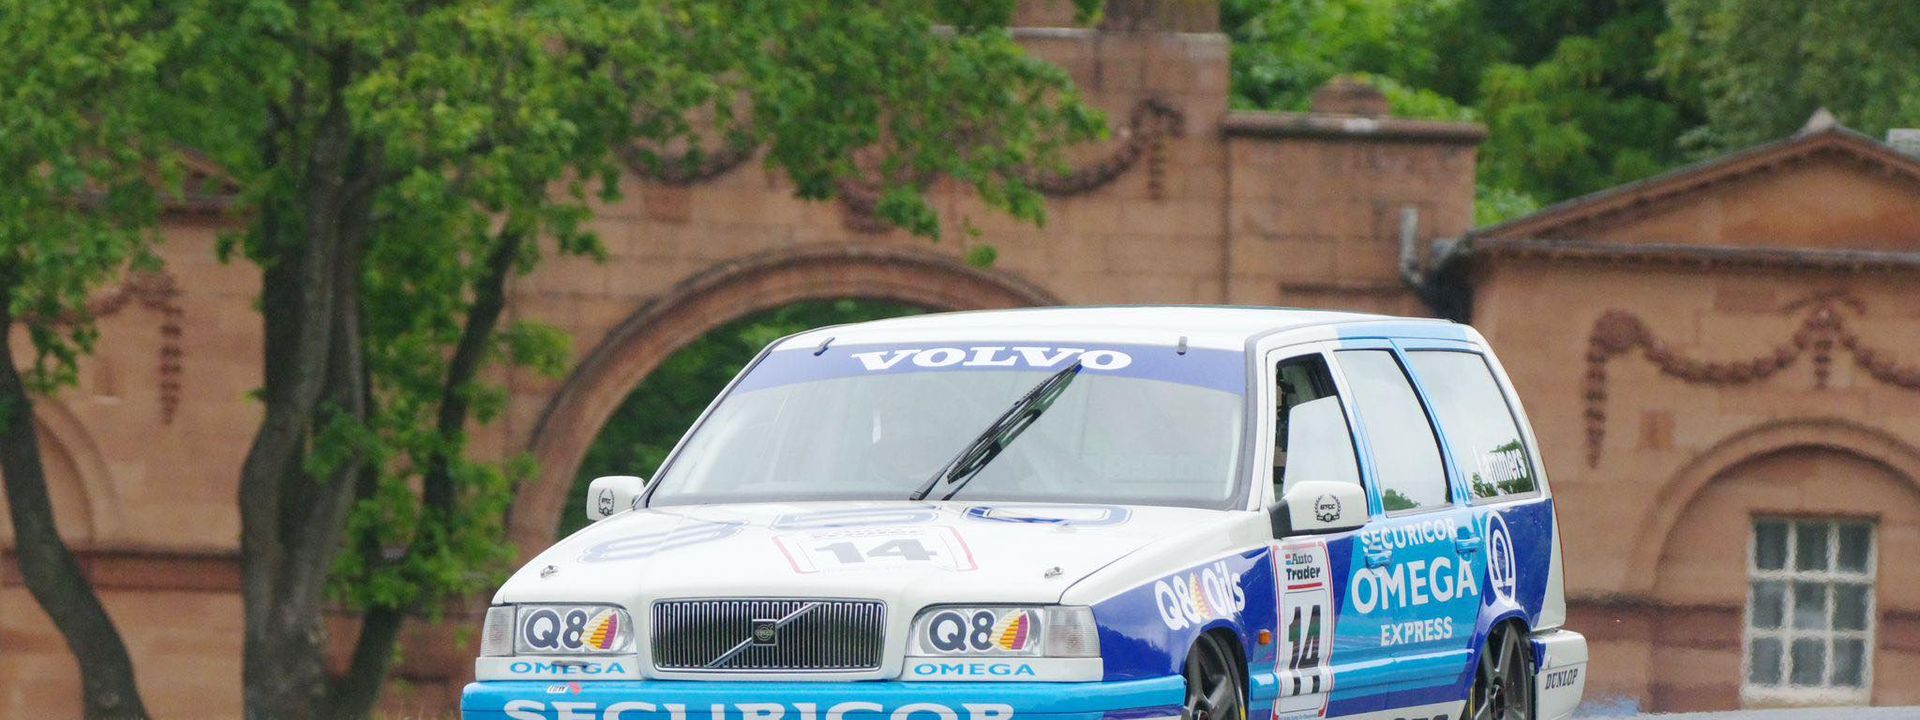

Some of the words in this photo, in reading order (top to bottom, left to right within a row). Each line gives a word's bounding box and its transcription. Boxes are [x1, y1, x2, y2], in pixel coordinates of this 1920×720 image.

[850, 346, 1132, 371] VOLVO
[1360, 519, 1457, 551] SECURICOR
[814, 538, 938, 564] 14
[1291, 553, 1313, 565] Auto
[1286, 566, 1321, 581] Trader
[1351, 556, 1478, 615] OMEGA
[1154, 576, 1201, 631] Q8
[1202, 561, 1246, 616] Oils
[524, 608, 588, 650] Q8
[928, 609, 995, 652] Q8
[1380, 616, 1453, 647] EXPRESS
[1288, 605, 1321, 696] 14
[509, 661, 625, 675] OMEGA
[914, 663, 1036, 676] OMEGA
[1545, 668, 1579, 690] DUNLOP
